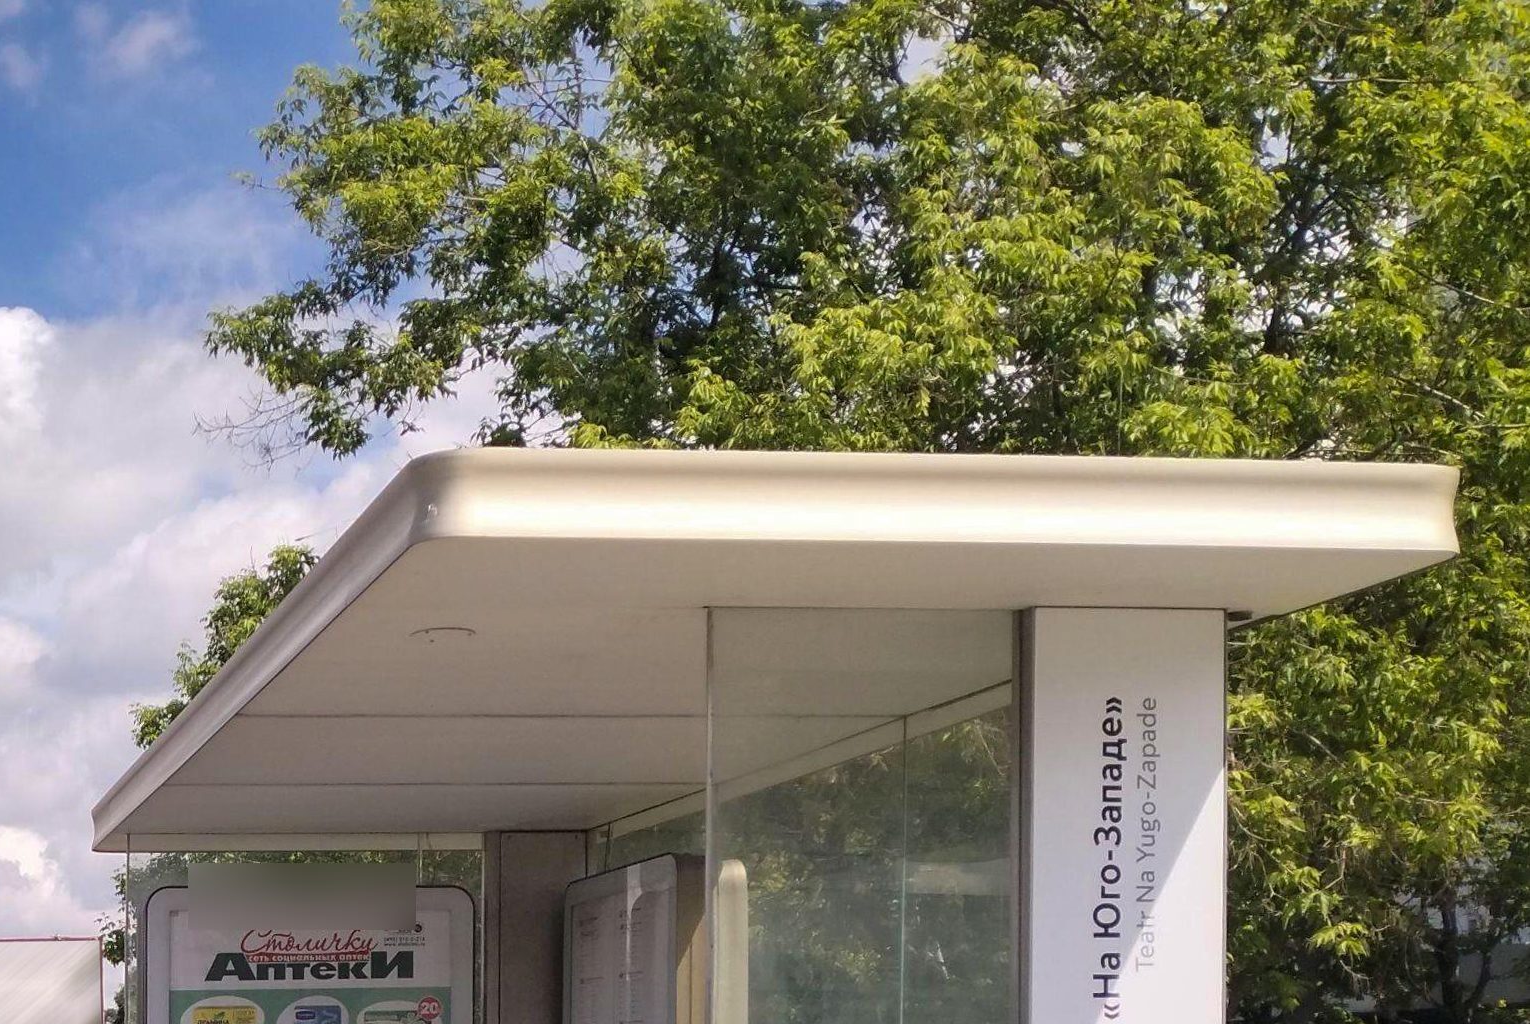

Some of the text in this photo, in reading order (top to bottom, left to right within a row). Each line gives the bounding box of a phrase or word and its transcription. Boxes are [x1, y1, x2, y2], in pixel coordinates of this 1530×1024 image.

[1092, 697, 1128, 939] Юго-Западе»
[1136, 697, 1161, 972] Teatr Na Yugo-Zapade
[240, 929, 378, 953] Столички
[422, 1001, 438, 1014] 20
[1092, 952, 1122, 1021] «На
